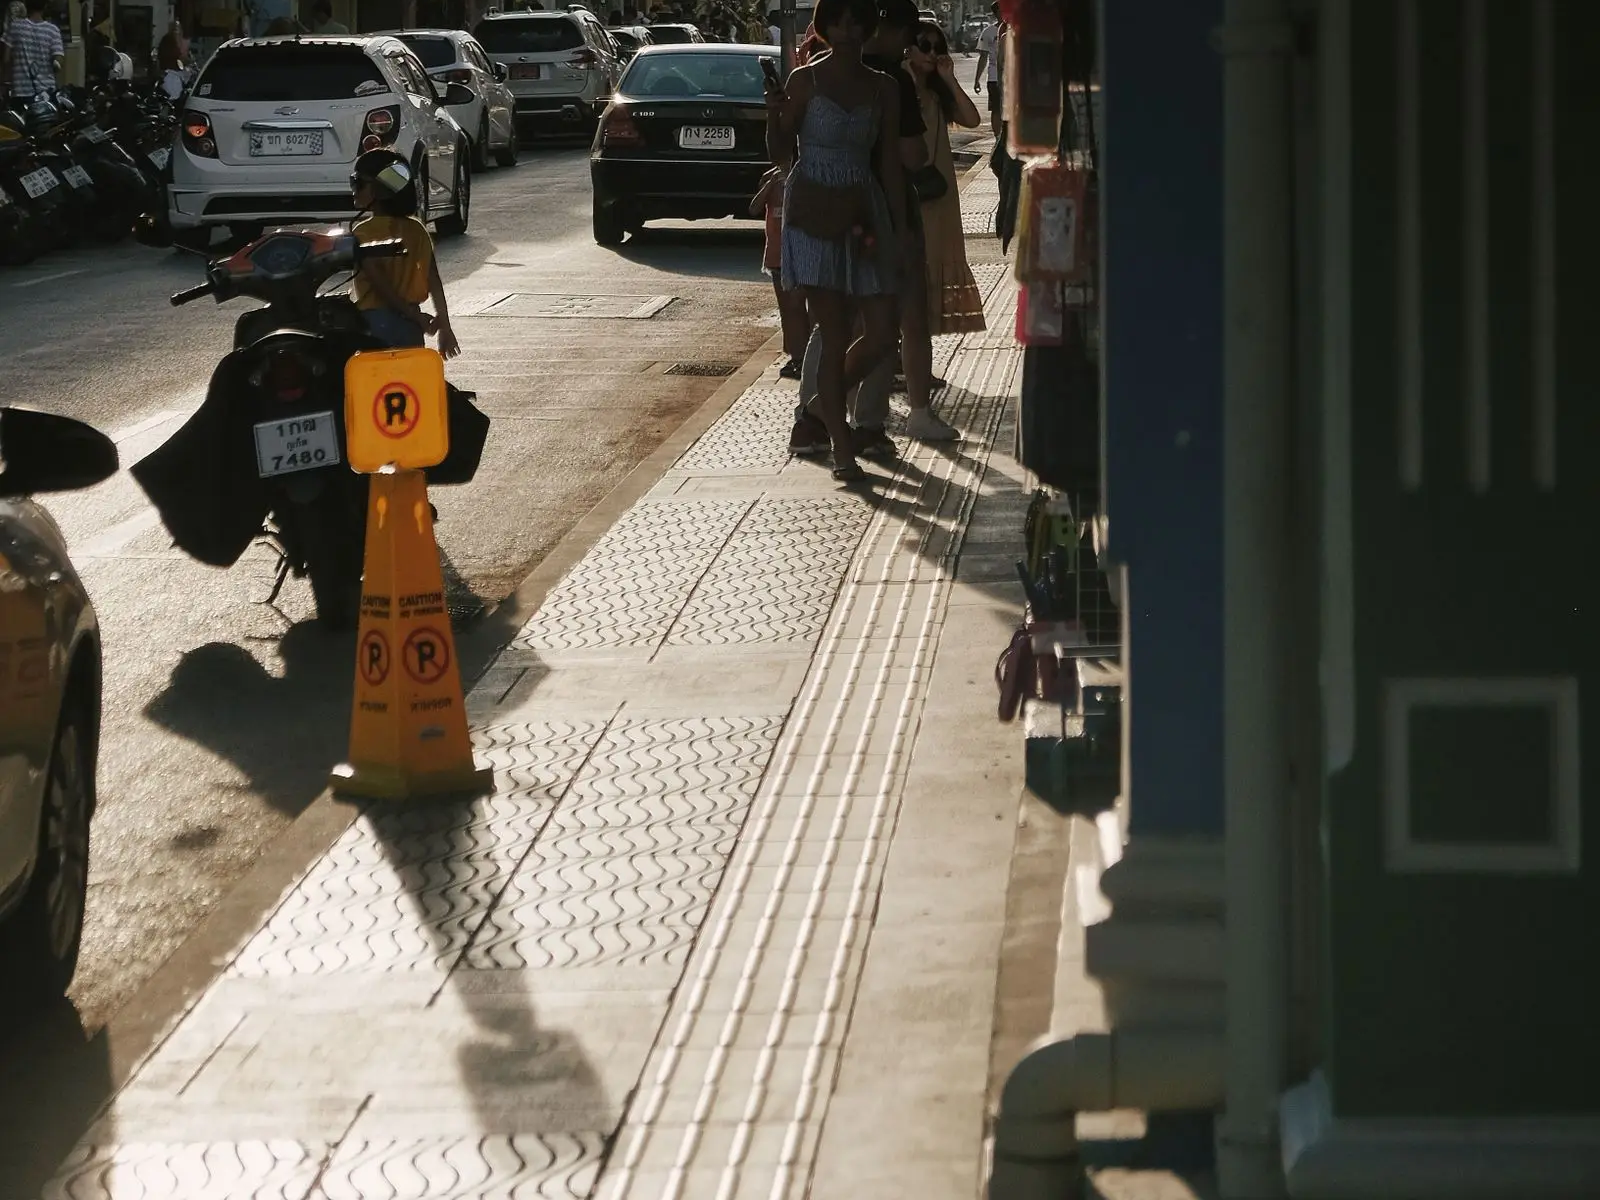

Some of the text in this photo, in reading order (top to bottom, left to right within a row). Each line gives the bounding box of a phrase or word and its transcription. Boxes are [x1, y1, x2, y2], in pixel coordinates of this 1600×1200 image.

[286, 135, 309, 145] 6027
[704, 127, 730, 139] 2258
[271, 448, 326, 470] 7480
[398, 591, 442, 608] CAUTION
